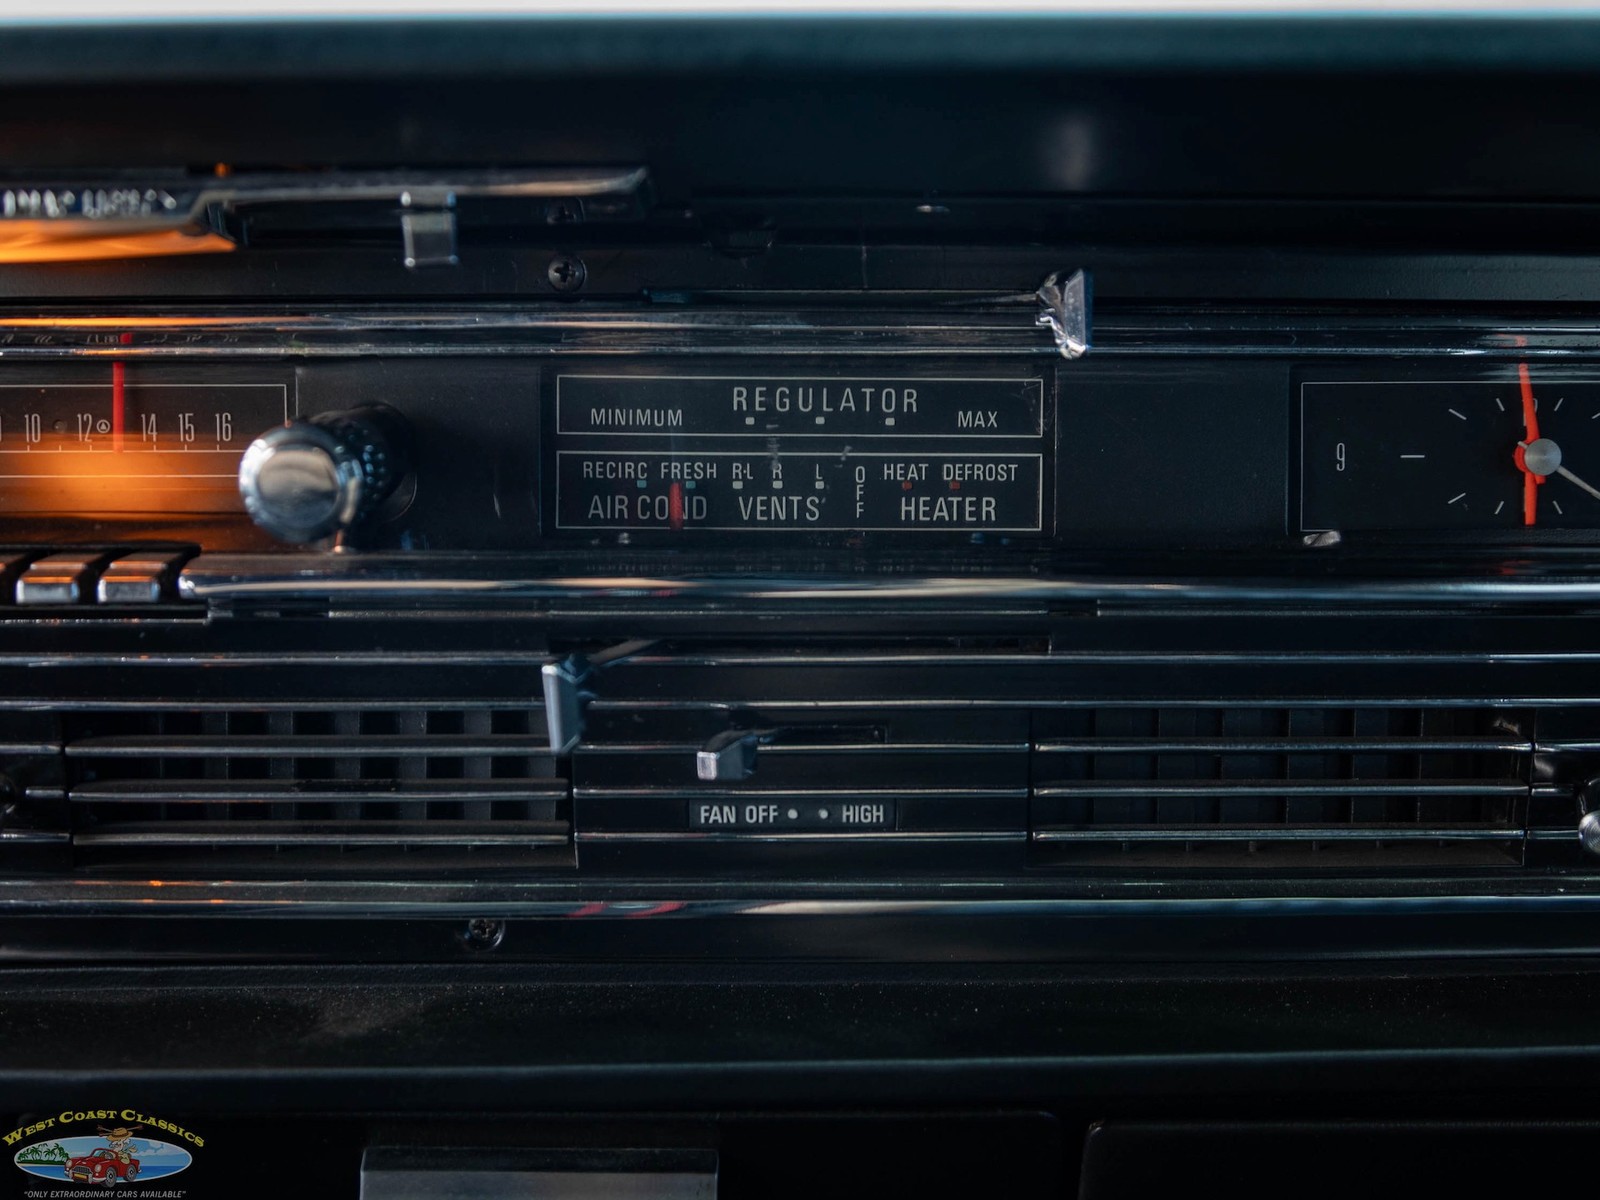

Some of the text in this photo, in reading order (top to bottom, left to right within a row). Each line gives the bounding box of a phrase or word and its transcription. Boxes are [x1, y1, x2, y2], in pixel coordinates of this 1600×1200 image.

[733, 387, 918, 413] REGULATOR
[24, 413, 41, 443] 10
[77, 412, 93, 442] 12
[141, 413, 158, 442] 14
[178, 412, 195, 442] 15
[215, 412, 232, 442] 16
[591, 408, 683, 427] MINIMUM
[958, 411, 998, 427] MAX
[1336, 442, 1346, 471] 9
[583, 462, 717, 479] RECIRC FRESH
[816, 464, 823, 479] L
[884, 464, 1017, 481] HEAT DEFROST
[588, 496, 628, 520] AIR
[739, 497, 820, 521] VENTS
[901, 497, 996, 522] HEATER
[701, 805, 884, 824] FAN OFF HIGH
